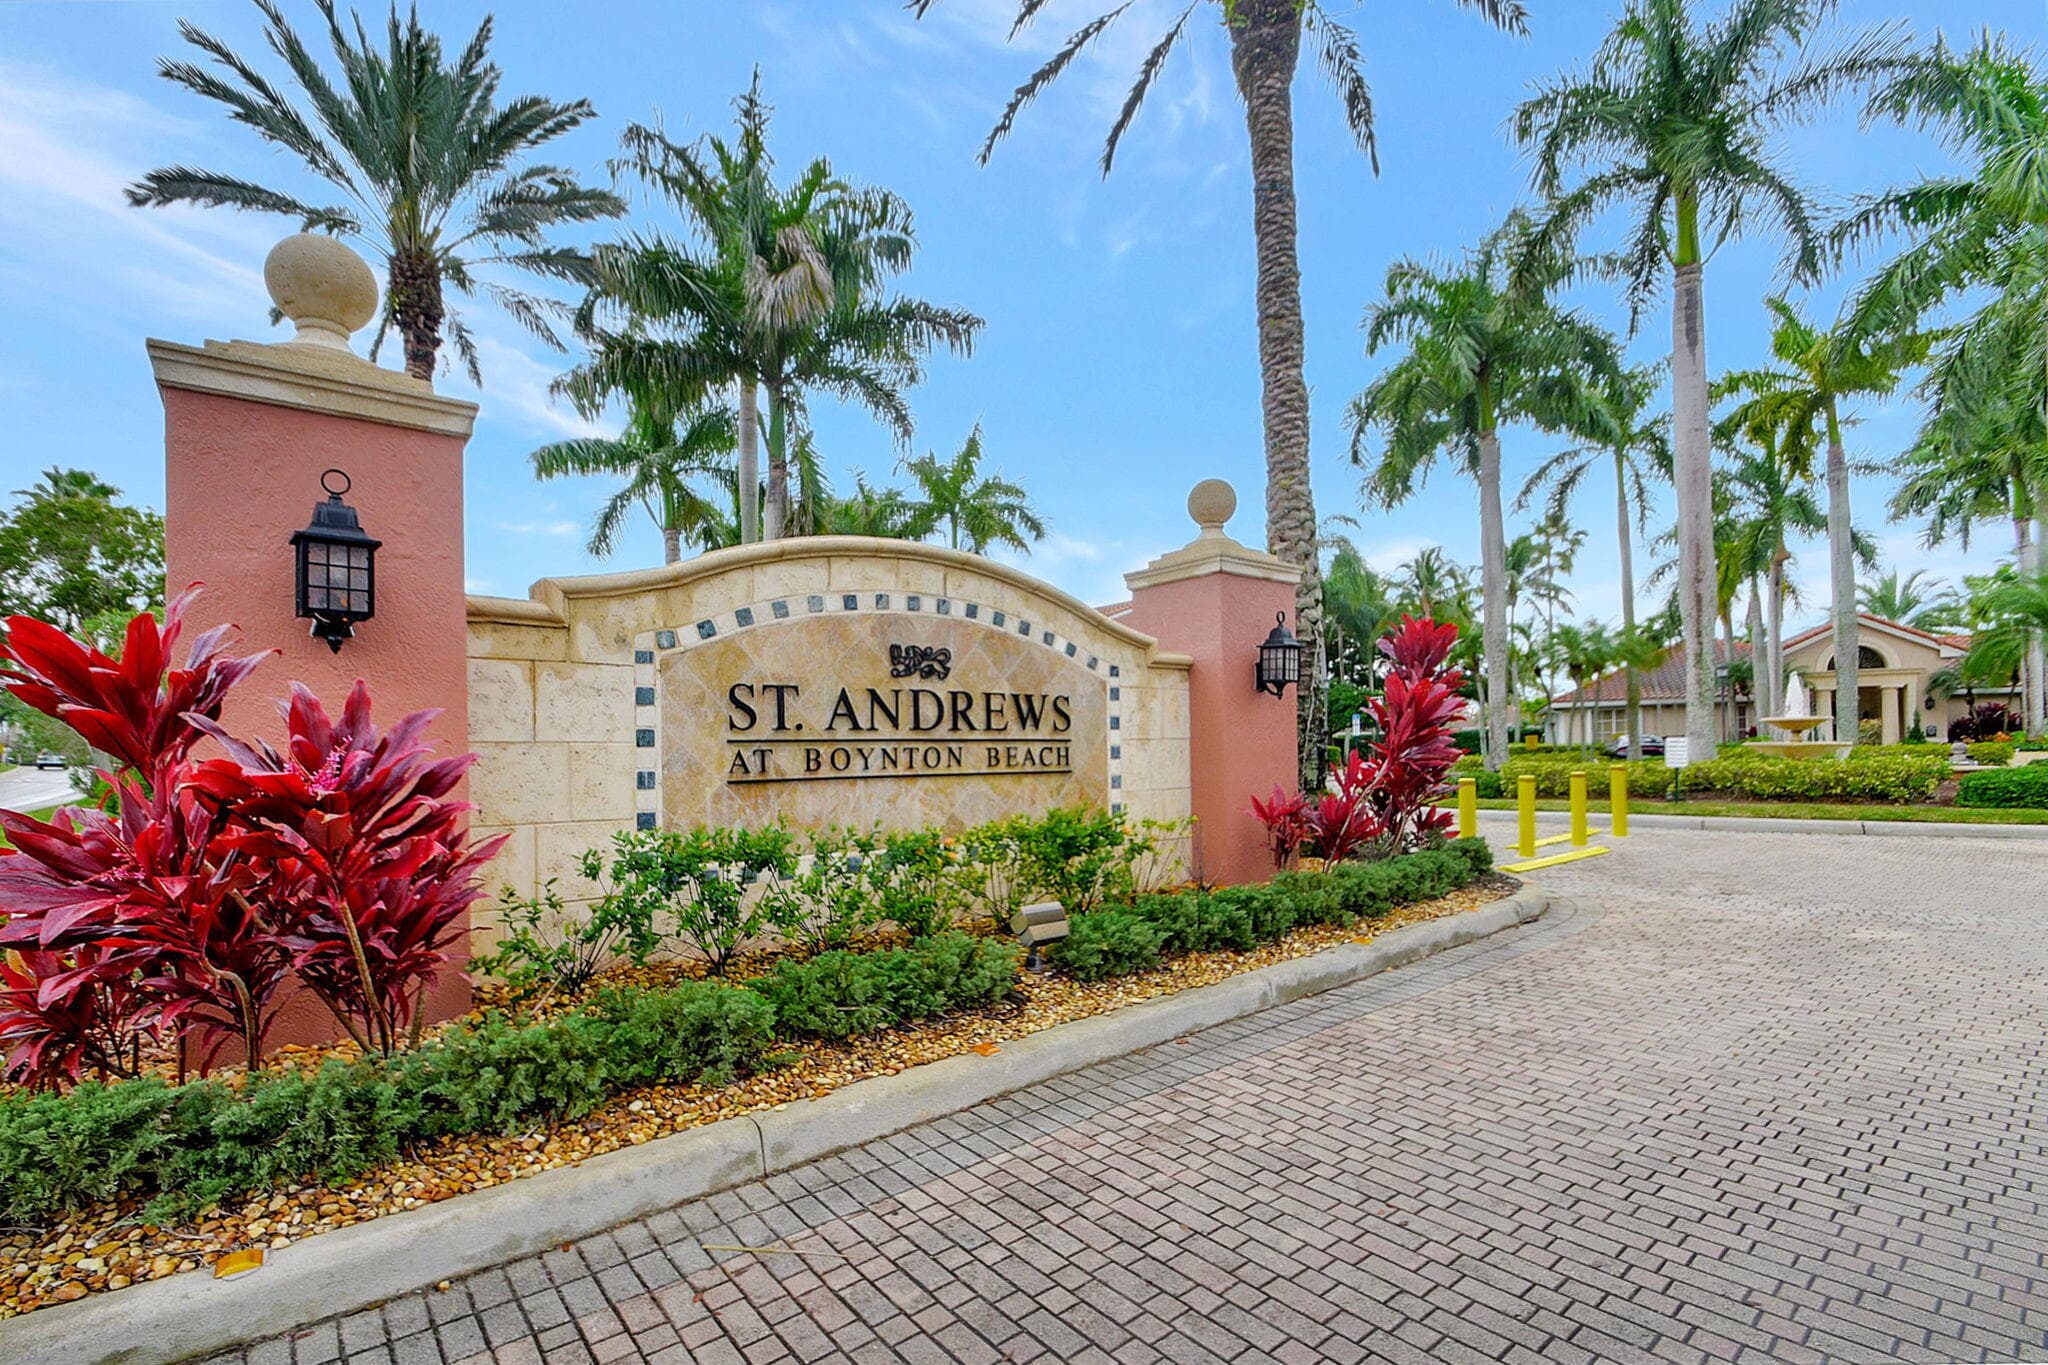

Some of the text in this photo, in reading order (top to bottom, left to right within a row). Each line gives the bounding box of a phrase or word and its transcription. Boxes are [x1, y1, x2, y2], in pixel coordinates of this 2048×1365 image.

[728, 682, 1072, 732] ST. ANDREWS
[729, 745, 1070, 775] AT BOYNTON BEACH
